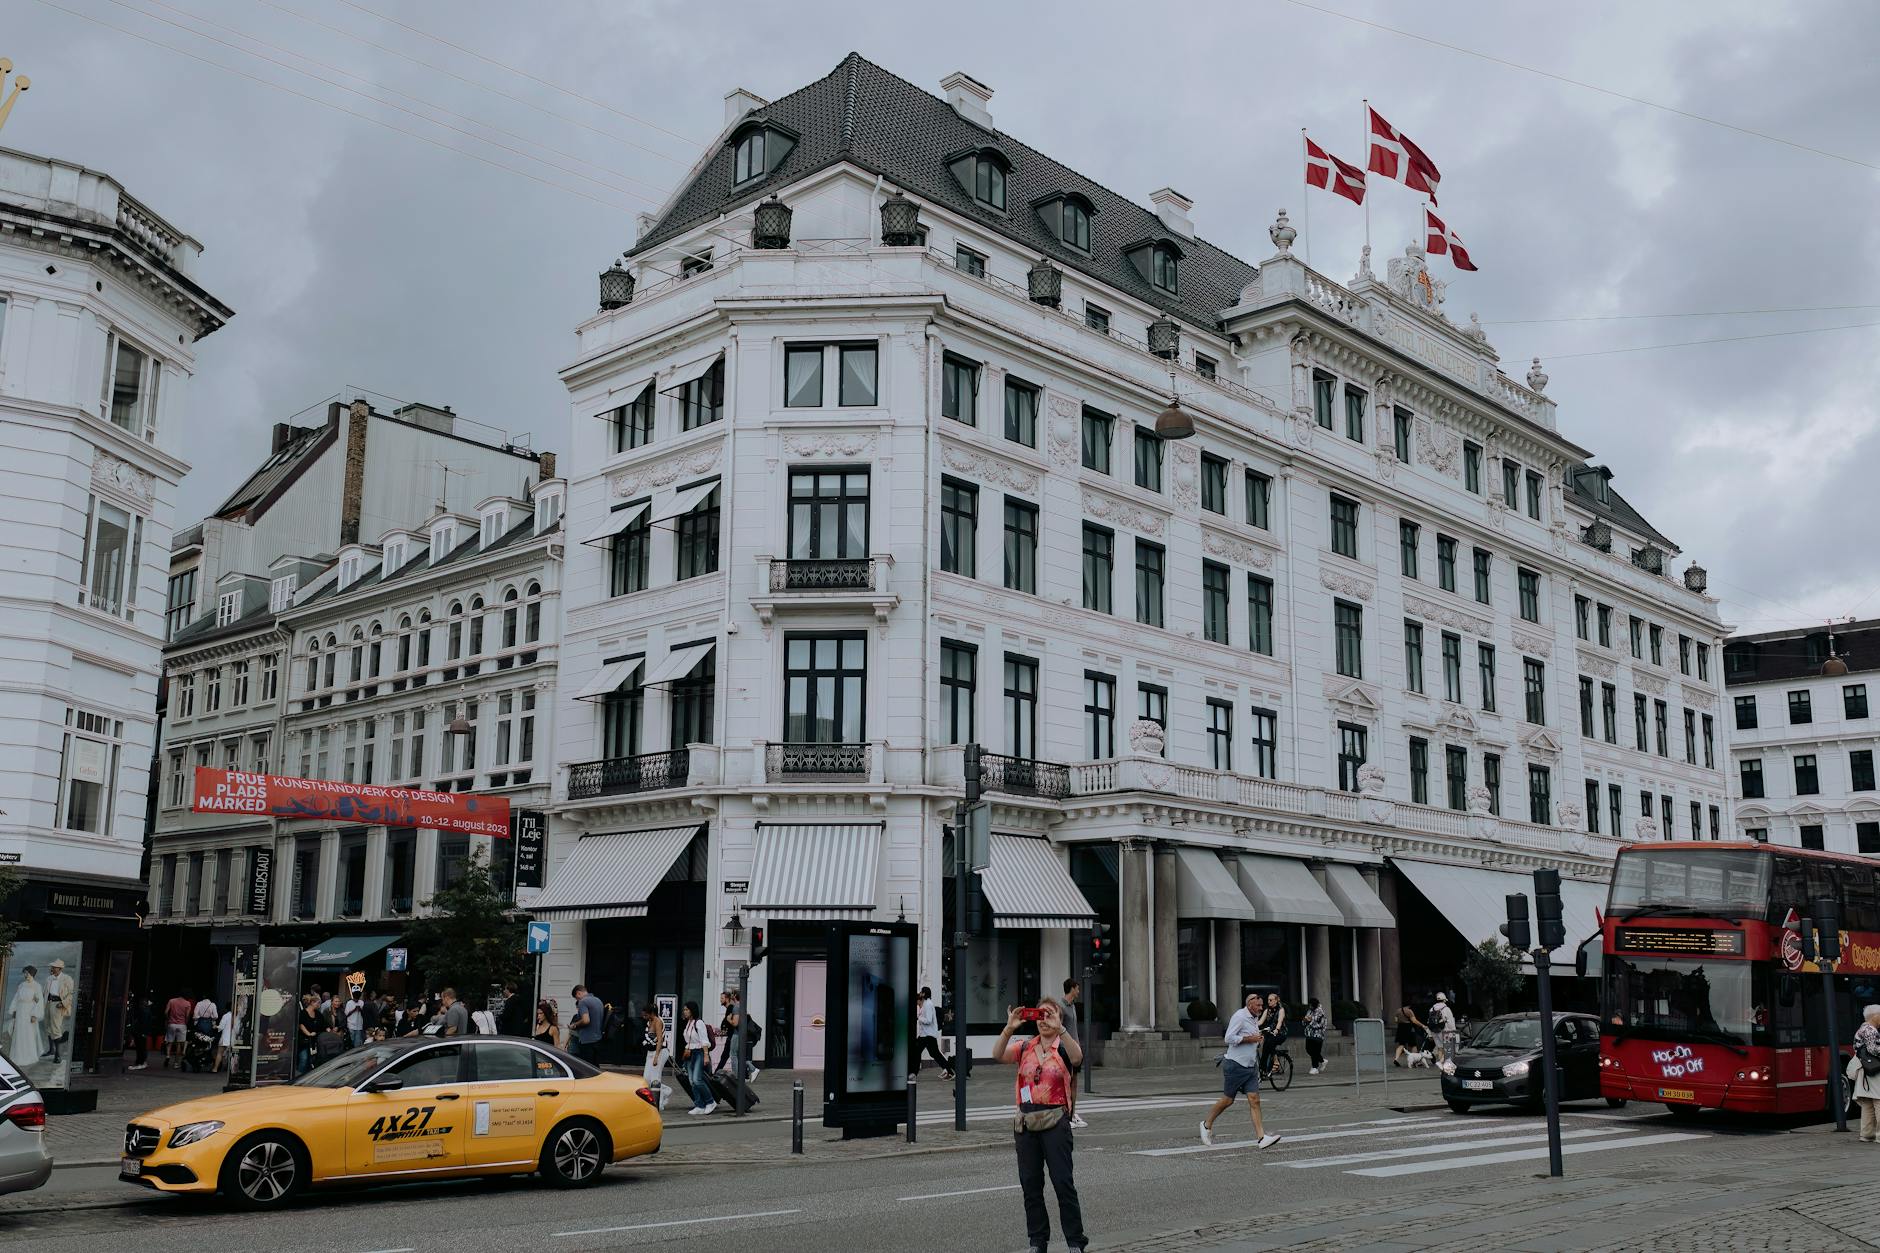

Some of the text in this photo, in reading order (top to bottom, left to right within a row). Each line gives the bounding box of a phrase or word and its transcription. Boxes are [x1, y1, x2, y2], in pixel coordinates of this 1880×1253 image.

[226, 772, 266, 785] FRUE
[217, 784, 267, 798] PLADS
[273, 777, 455, 804] KUNSTHÅNDVÆRK OG DESIGN
[199, 796, 266, 811] MARKED
[421, 815, 508, 835] 10.-12. august 2023
[522, 818, 536, 829] Til
[521, 828, 541, 841] Leje
[253, 851, 270, 912] HALBERSTADT
[1662, 1057, 1703, 1077] Hop Off
